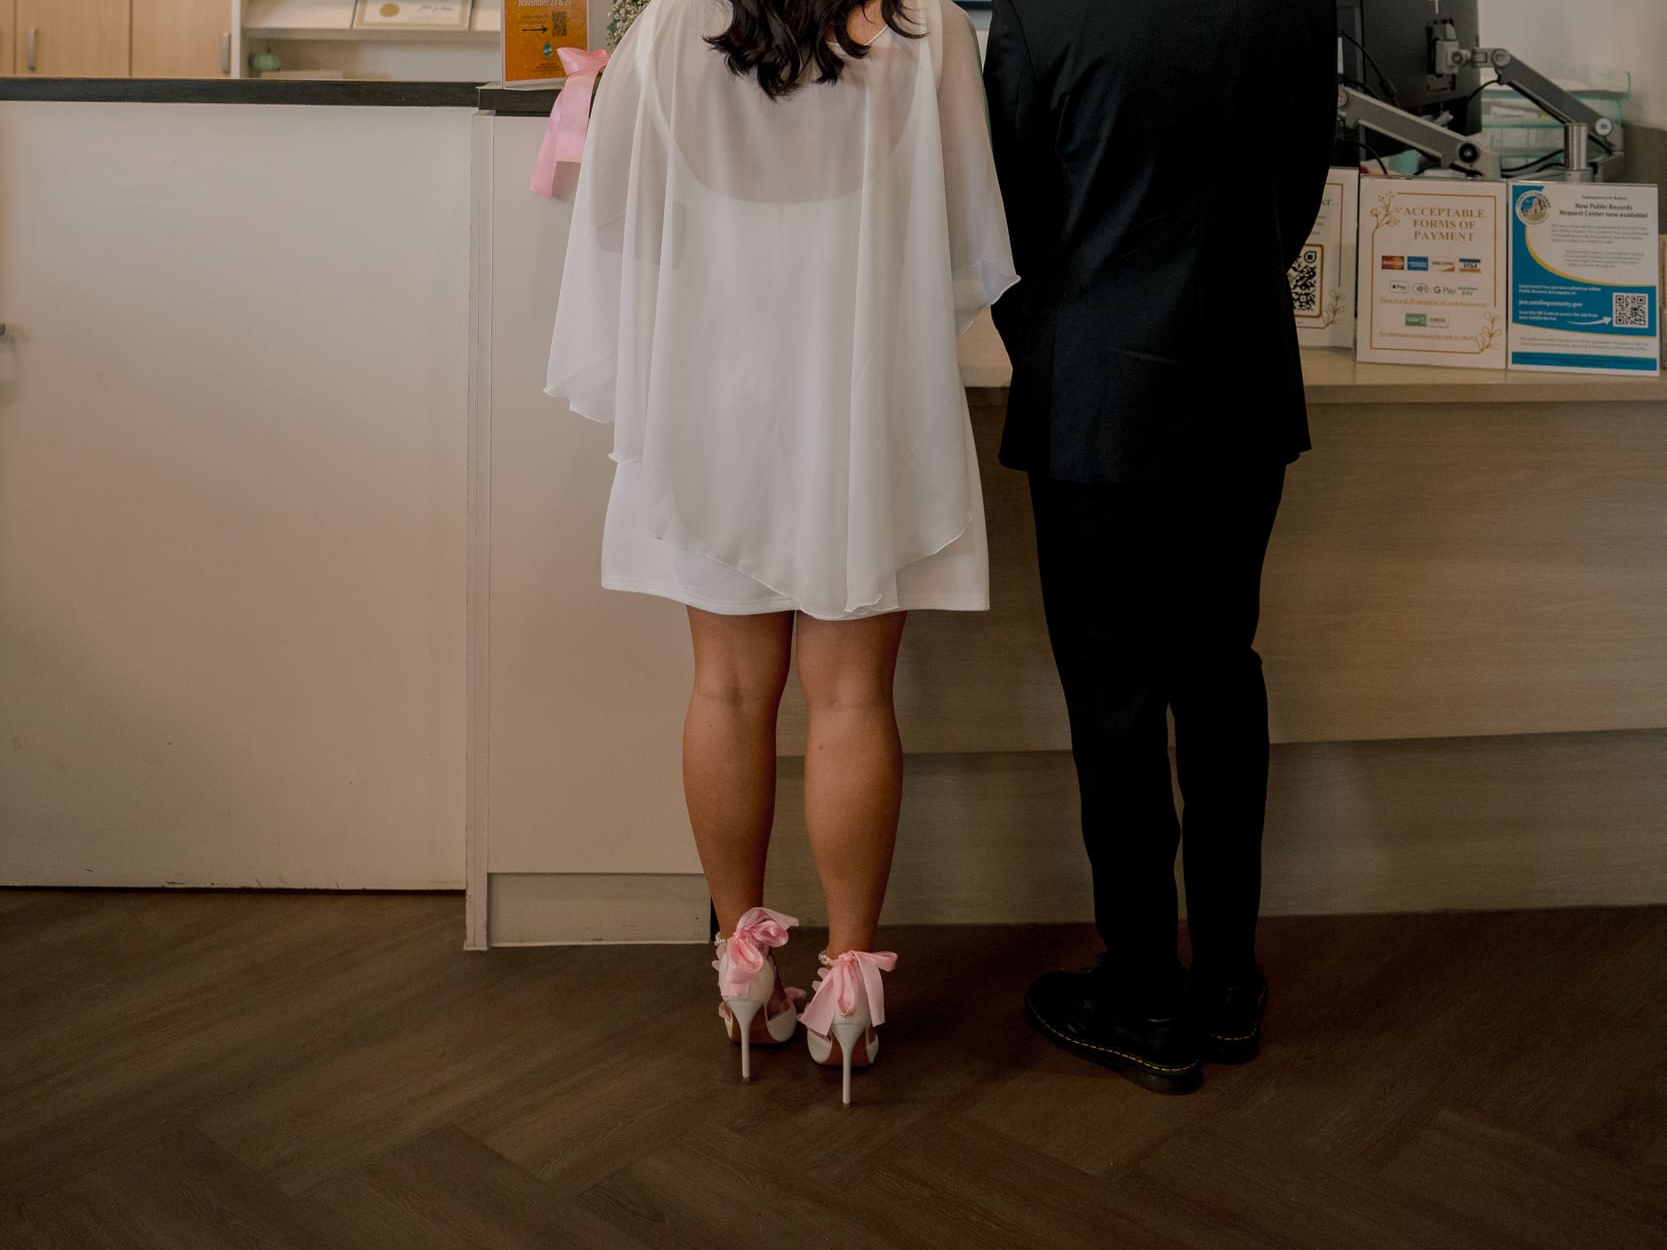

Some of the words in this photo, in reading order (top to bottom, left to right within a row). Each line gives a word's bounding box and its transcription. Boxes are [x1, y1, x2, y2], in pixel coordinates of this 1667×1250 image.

[1404, 207, 1486, 218] ACCEPTABLE
[1413, 219, 1456, 229] FORMS
[1459, 221, 1475, 230] OF
[1414, 231, 1475, 242] PAYMENT
